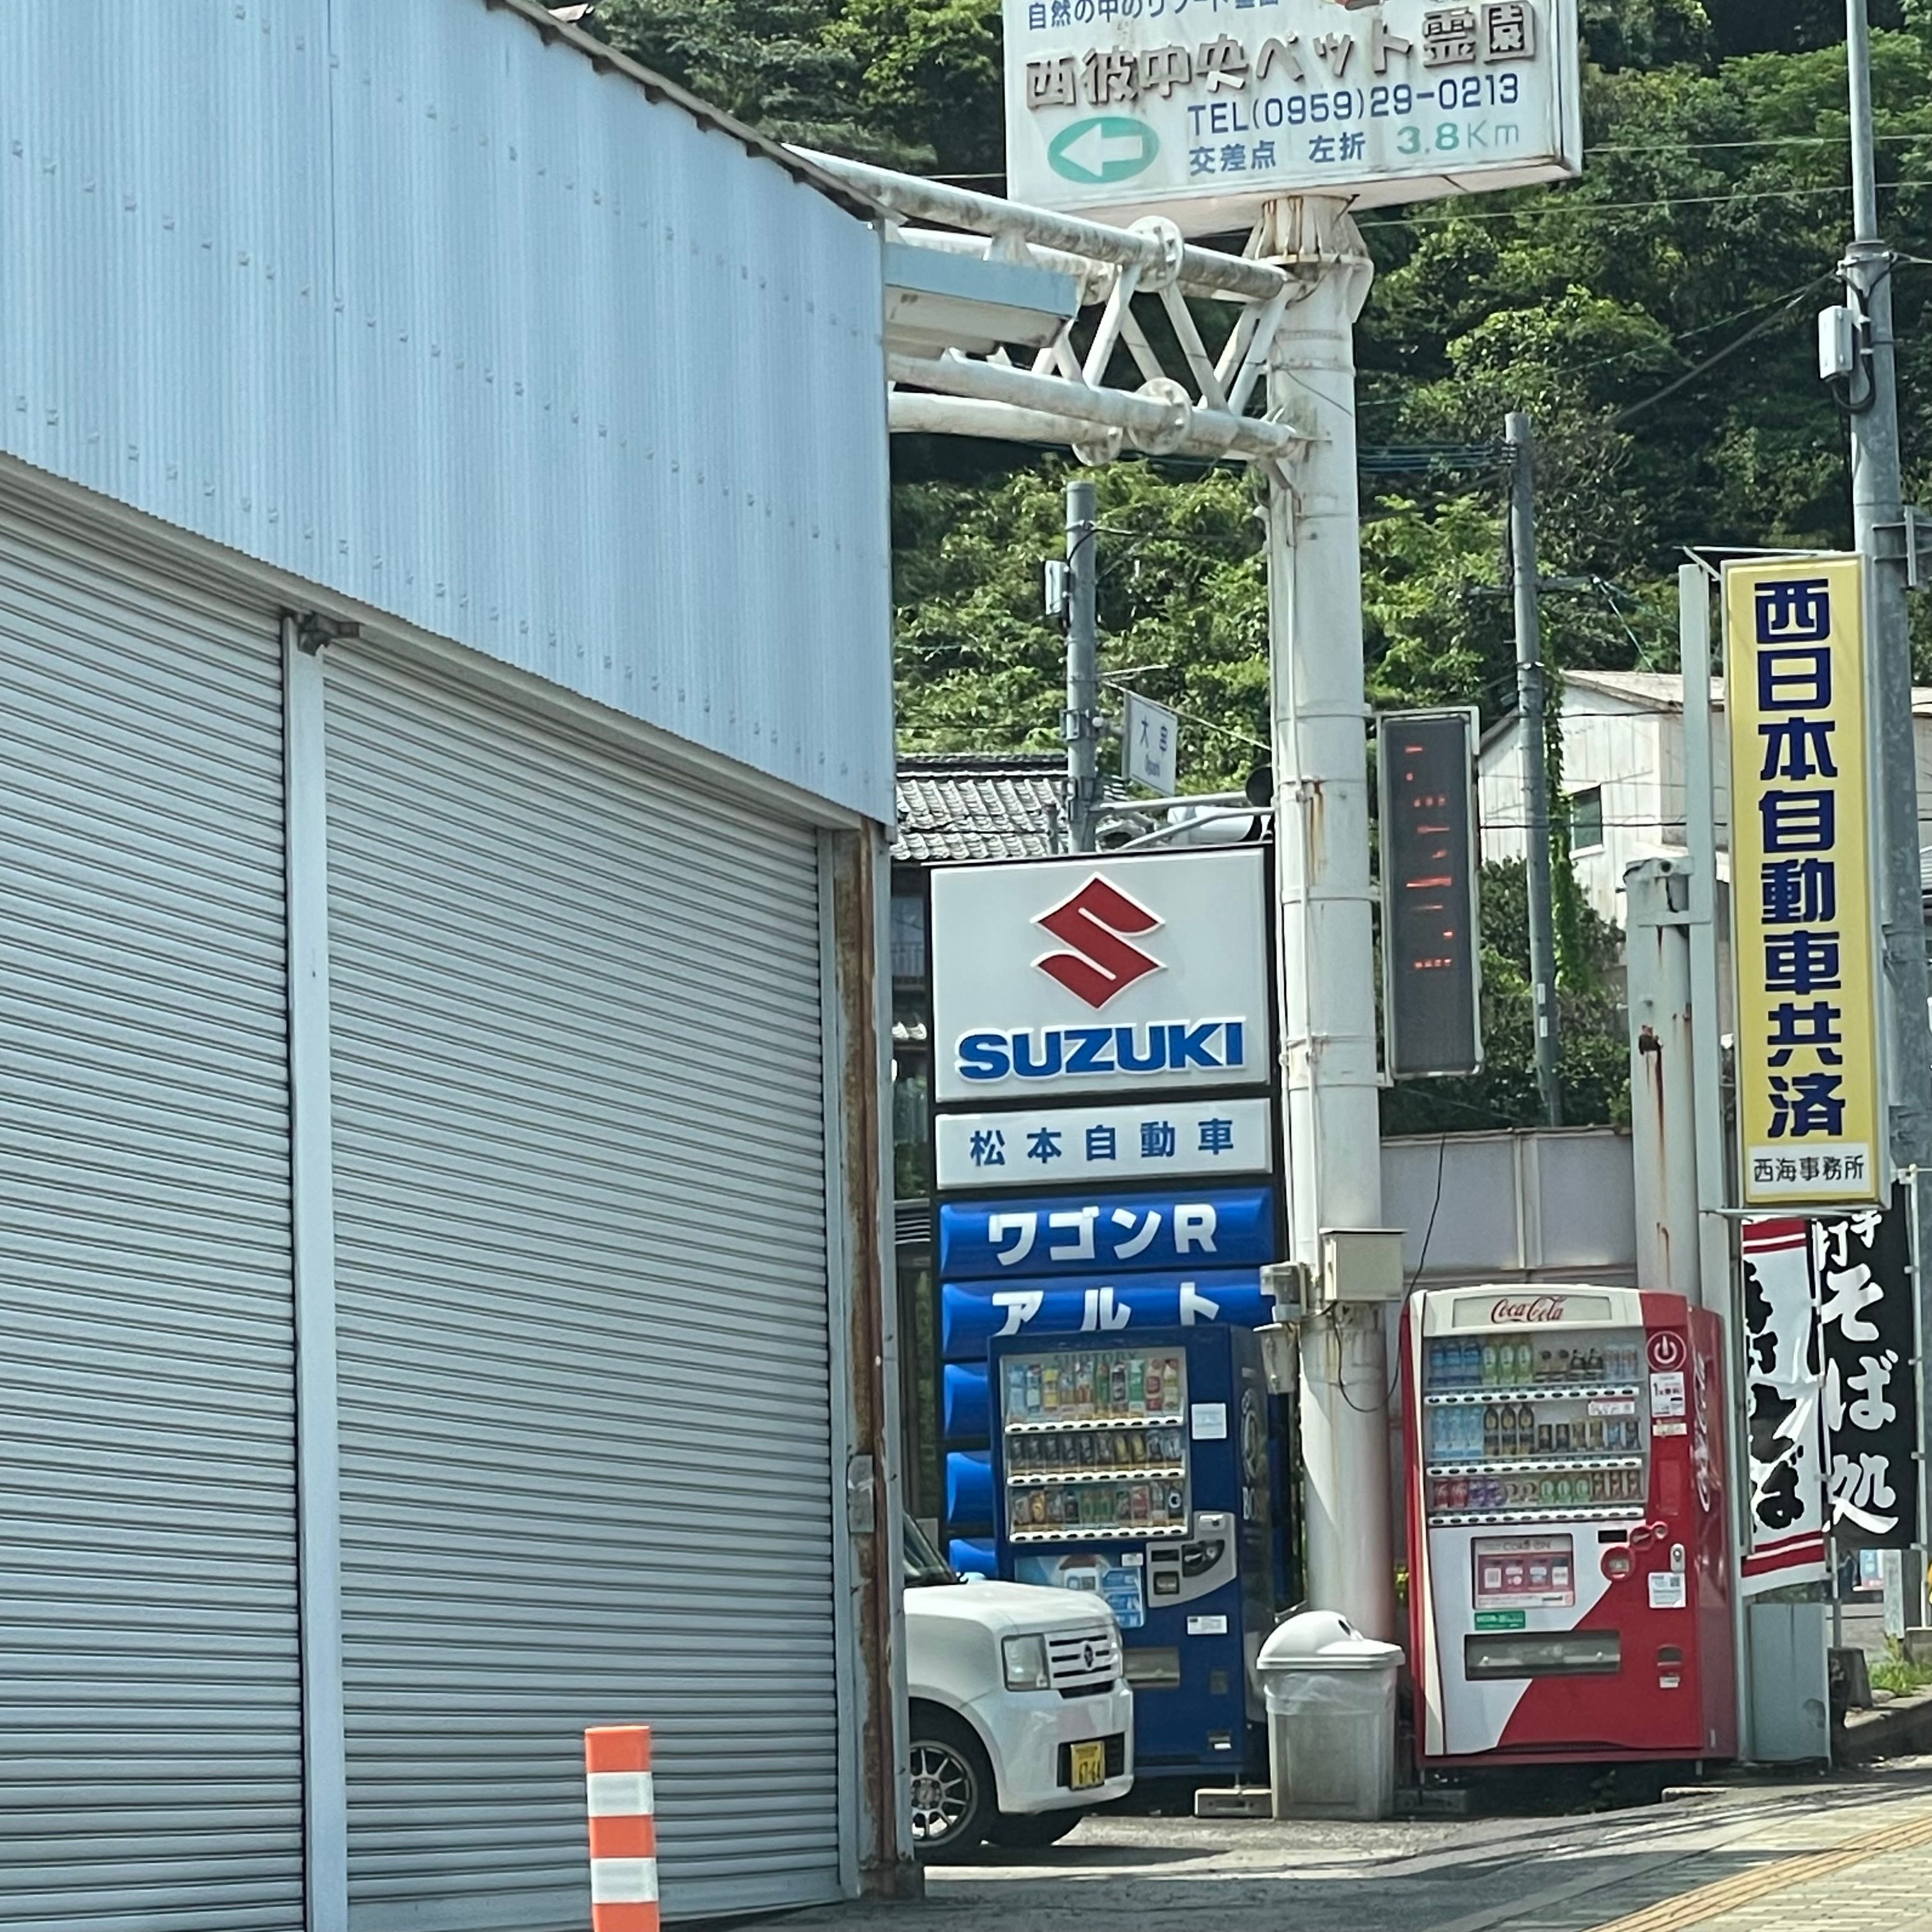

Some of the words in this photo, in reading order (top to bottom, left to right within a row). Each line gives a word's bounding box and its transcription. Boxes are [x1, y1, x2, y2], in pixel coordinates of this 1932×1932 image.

[1187, 73, 1519, 136] TEL(0959)29-0213
[1189, 141, 1276, 176] 交差点
[1308, 132, 1366, 163] 左折
[1754, 578, 1846, 1138] 西日本自動車共済
[954, 1017, 1246, 1082] SUZUKI
[970, 1118, 1234, 1167] 松本自動車
[1753, 1154, 1864, 1183] 西海事務所
[988, 1204, 1217, 1266] ワゴンR
